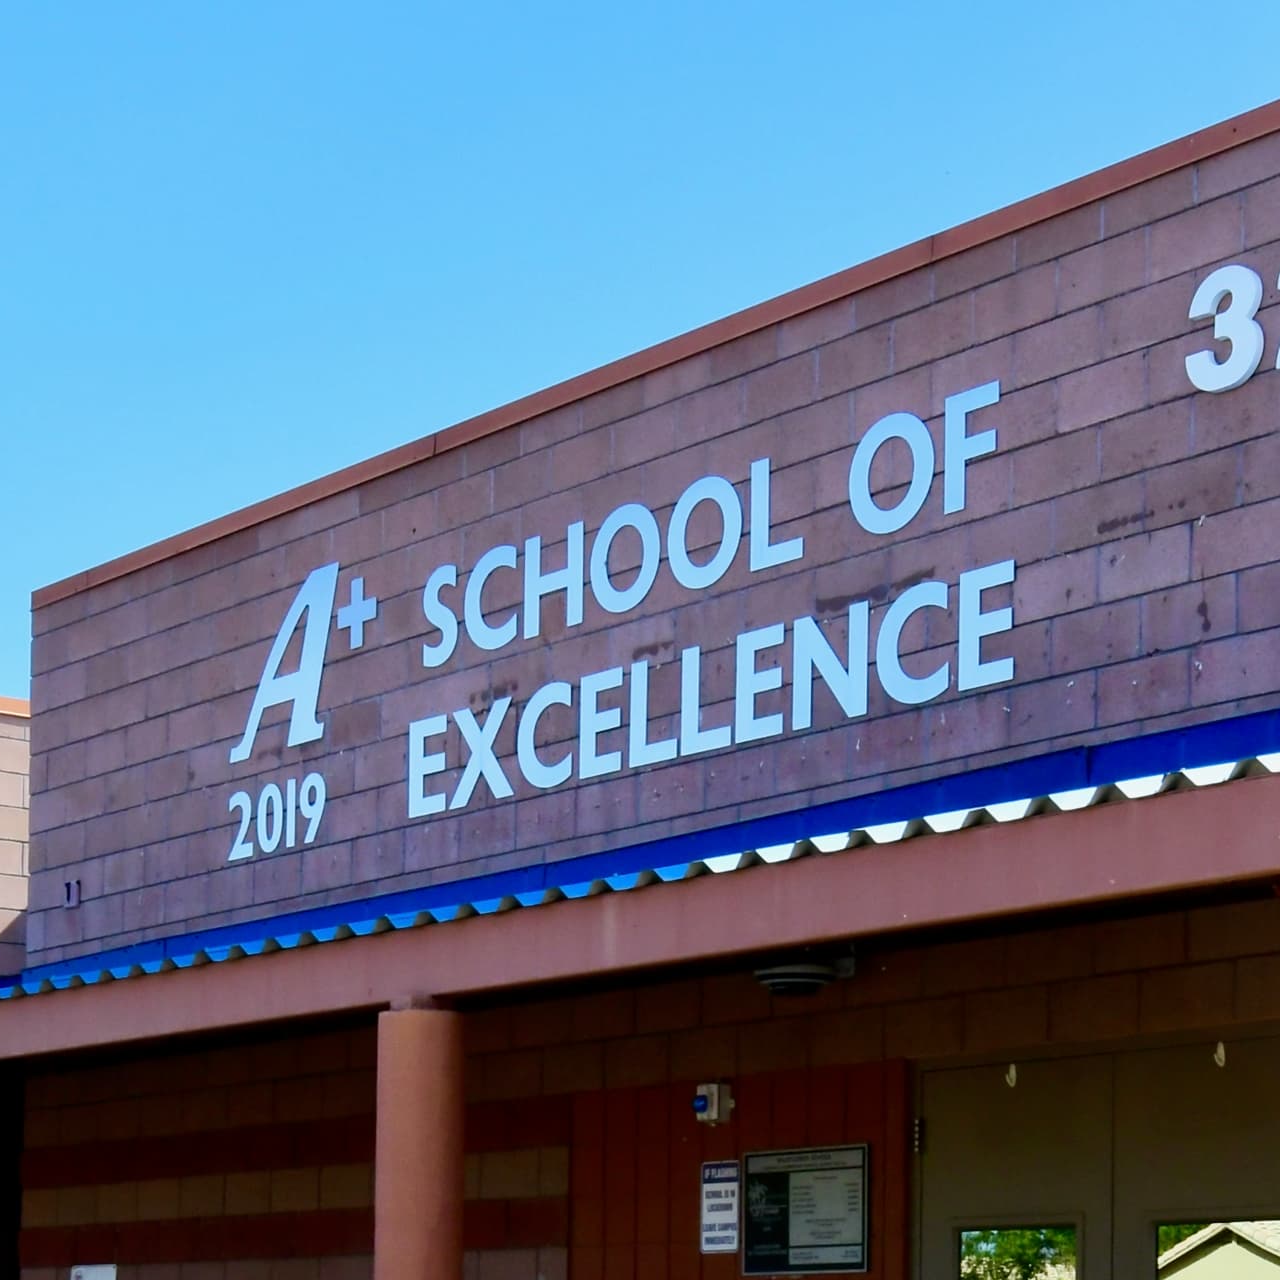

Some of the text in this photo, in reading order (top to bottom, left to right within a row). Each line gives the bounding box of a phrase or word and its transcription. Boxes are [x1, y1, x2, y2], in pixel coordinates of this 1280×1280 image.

[229, 379, 1001, 764] A+ SCHOOL OF
[407, 558, 1017, 820] EXCELLENCE
[227, 772, 326, 862] 2019
